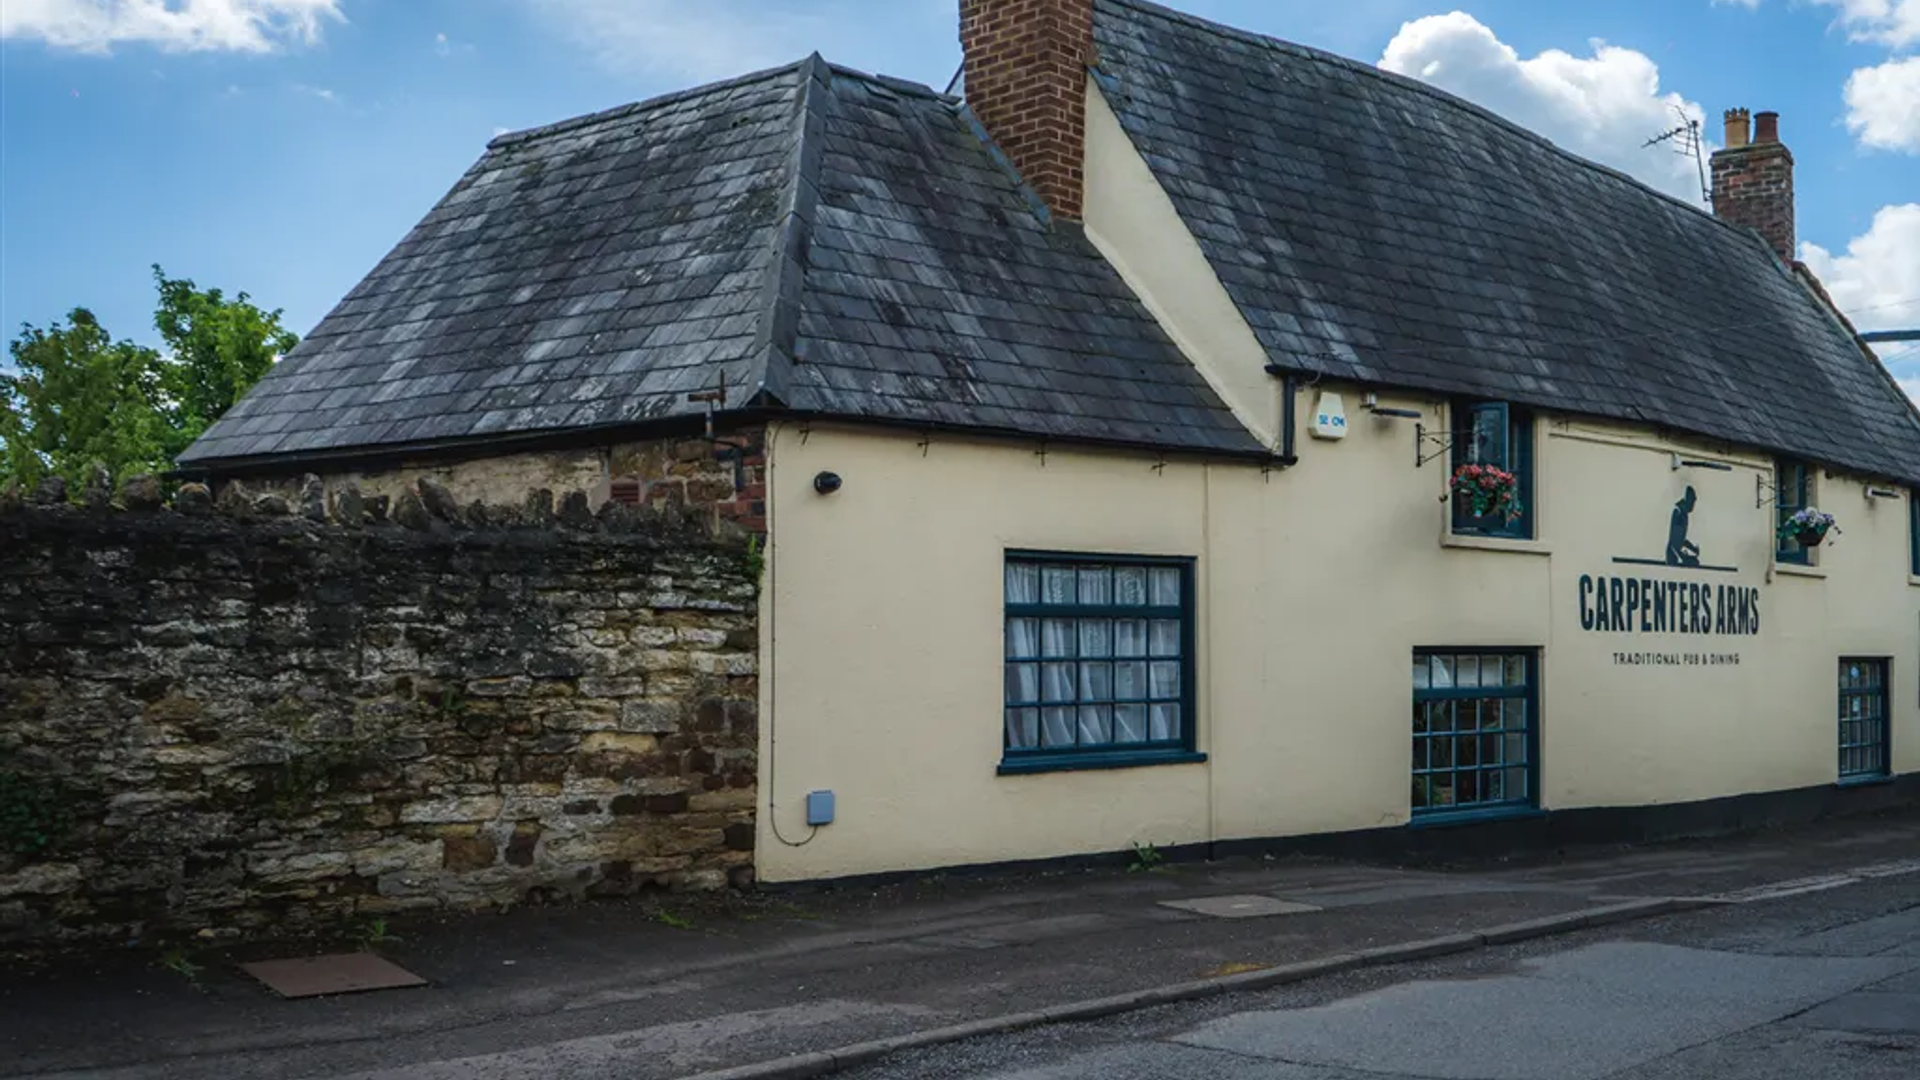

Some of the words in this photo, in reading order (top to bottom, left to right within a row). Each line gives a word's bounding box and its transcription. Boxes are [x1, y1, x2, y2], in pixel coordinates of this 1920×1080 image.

[1579, 574, 1712, 635] CARPENTERS
[1715, 584, 1759, 635] ARMS
[1613, 652, 1680, 665] TRADITIONAL
[1684, 653, 1699, 665] PUB
[1710, 653, 1739, 665] DINING
